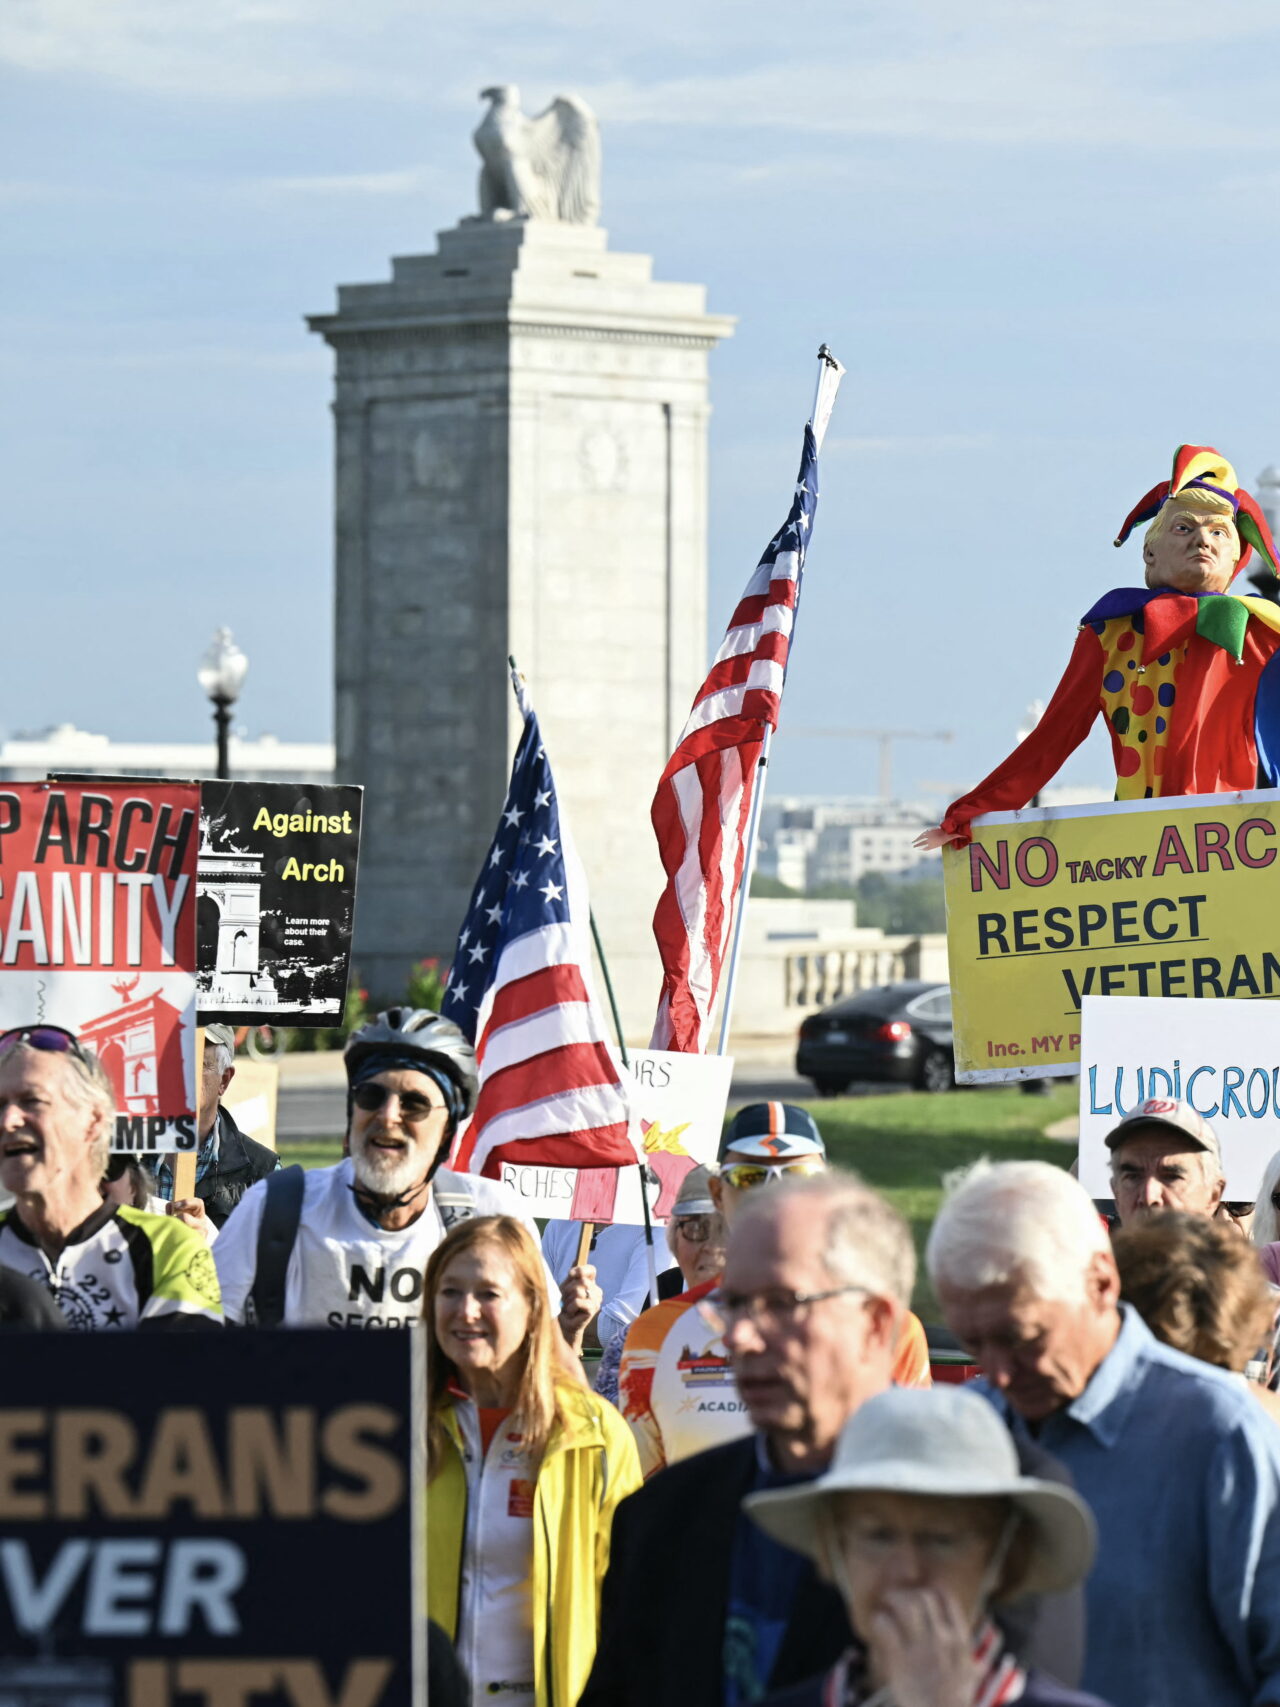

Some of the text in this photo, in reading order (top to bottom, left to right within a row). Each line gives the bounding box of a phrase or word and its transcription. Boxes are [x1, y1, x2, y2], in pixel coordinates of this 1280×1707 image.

[33, 790, 196, 881] ARCH
[253, 807, 353, 838] Against
[281, 856, 345, 883] Arch
[968, 836, 1059, 893] NO
[1065, 855, 1148, 884] TACKY
[0, 870, 191, 967] ANITY
[284, 927, 328, 937] about their
[285, 916, 330, 926] Learn more
[977, 894, 1207, 956] RESPECT
[283, 938, 305, 946] case.
[987, 1040, 1026, 1058] Inc.
[1031, 1034, 1063, 1054] MY
[109, 1114, 196, 1150] MP'S
[348, 1264, 423, 1303] NO
[0, 1404, 405, 1522] ERANS
[0, 1537, 247, 1637] VER
